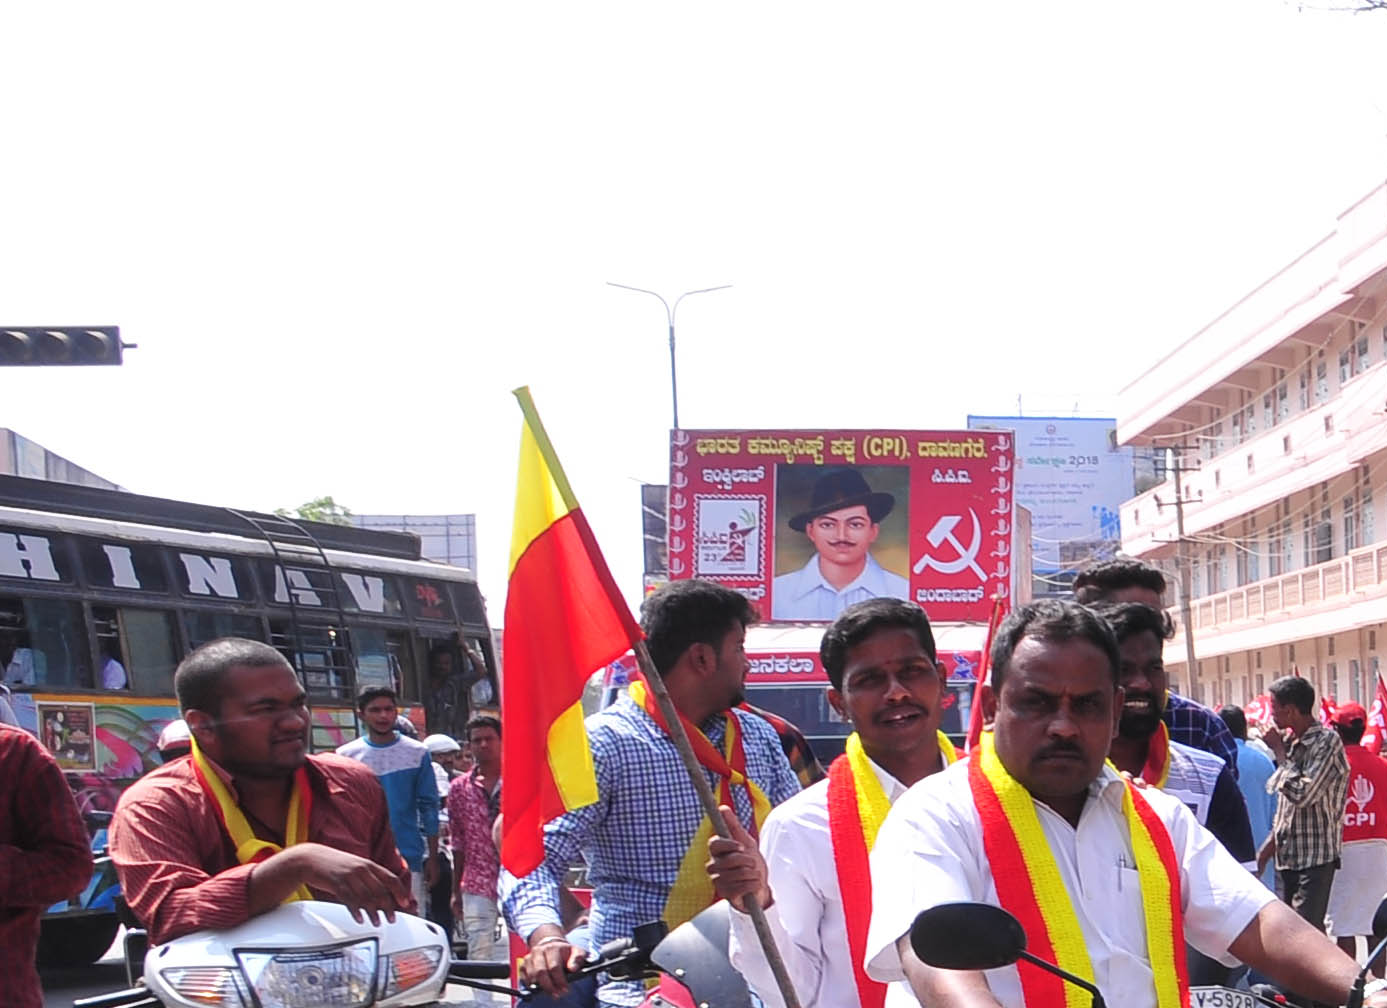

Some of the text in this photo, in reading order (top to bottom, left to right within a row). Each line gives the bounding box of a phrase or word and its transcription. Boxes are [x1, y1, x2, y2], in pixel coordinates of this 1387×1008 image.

[696, 436, 741, 457] ಭಾರತ
[830, 438, 857, 464] ಪಕ್ಷ
[1343, 812, 1376, 827] CPI
